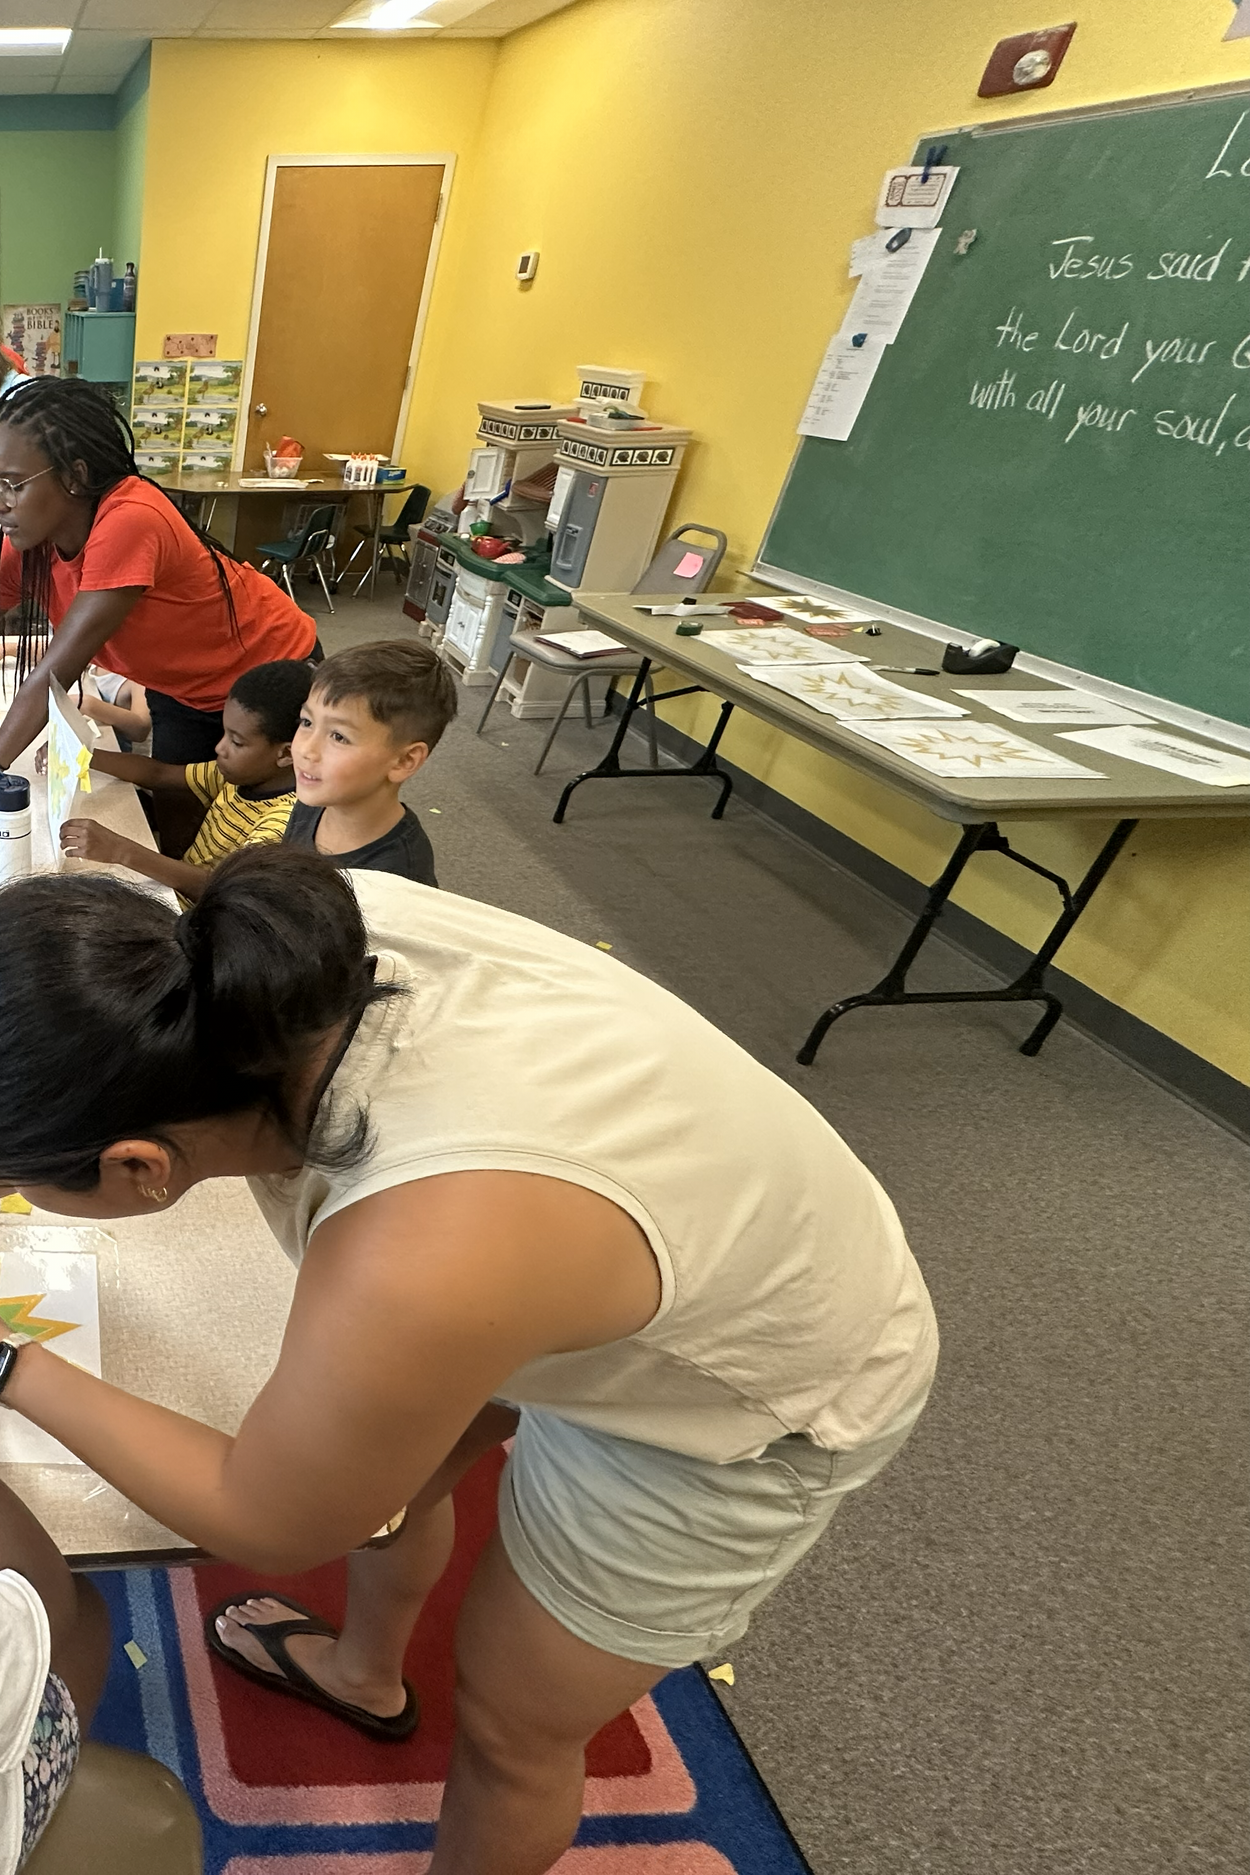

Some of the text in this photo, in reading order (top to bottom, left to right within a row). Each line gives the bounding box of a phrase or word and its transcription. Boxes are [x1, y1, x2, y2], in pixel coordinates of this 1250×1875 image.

[1050, 236, 1134, 280] Jesus
[1147, 235, 1233, 281] said
[27, 307, 53, 316] BOOKS
[27, 320, 53, 330] BIBLE
[996, 305, 1039, 351] the
[1054, 312, 1129, 359] Lord
[1132, 338, 1217, 383] your
[969, 369, 1017, 409] with
[1026, 379, 1066, 419] all
[1065, 402, 1137, 443] your
[1153, 393, 1236, 456] soul,
